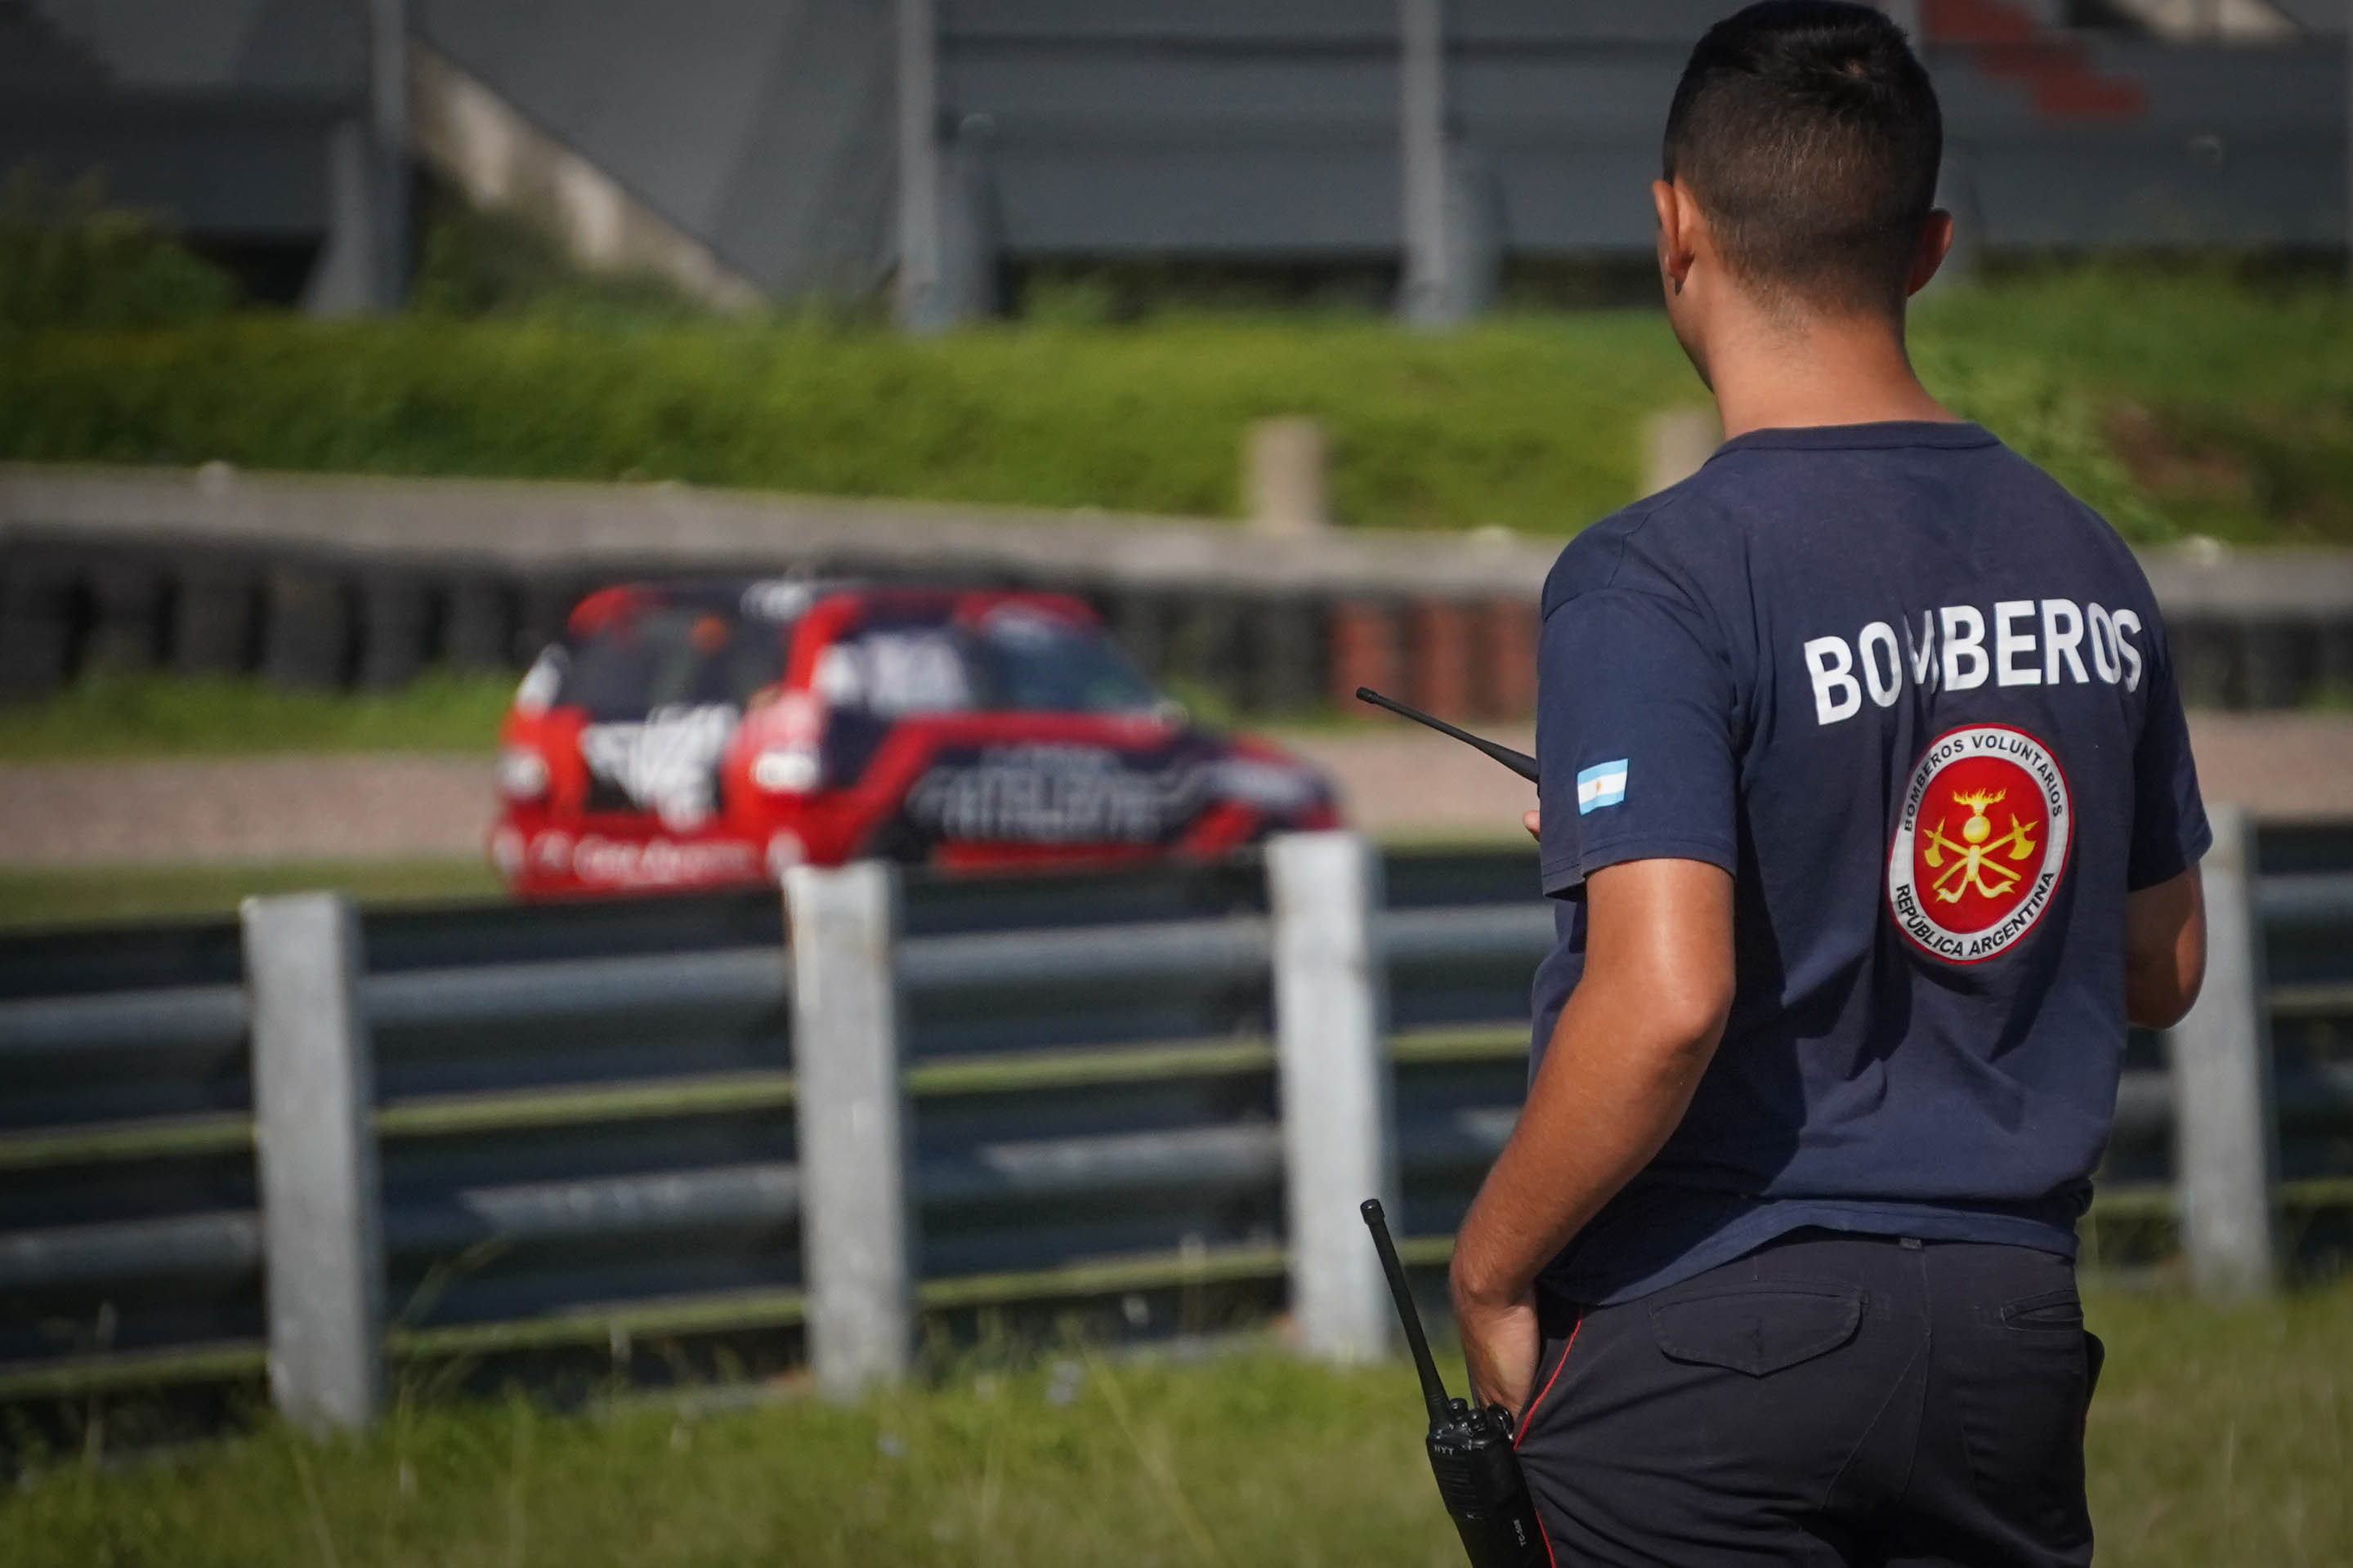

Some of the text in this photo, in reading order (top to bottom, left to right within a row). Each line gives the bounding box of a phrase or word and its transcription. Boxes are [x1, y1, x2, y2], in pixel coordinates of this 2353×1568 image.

[1804, 598, 2142, 726] BOMBEROS
[1904, 735, 2063, 832] BOMBEROS VOLUNTARIOS
[1896, 872, 2055, 956] REPÚBLICA ARGENTINA
